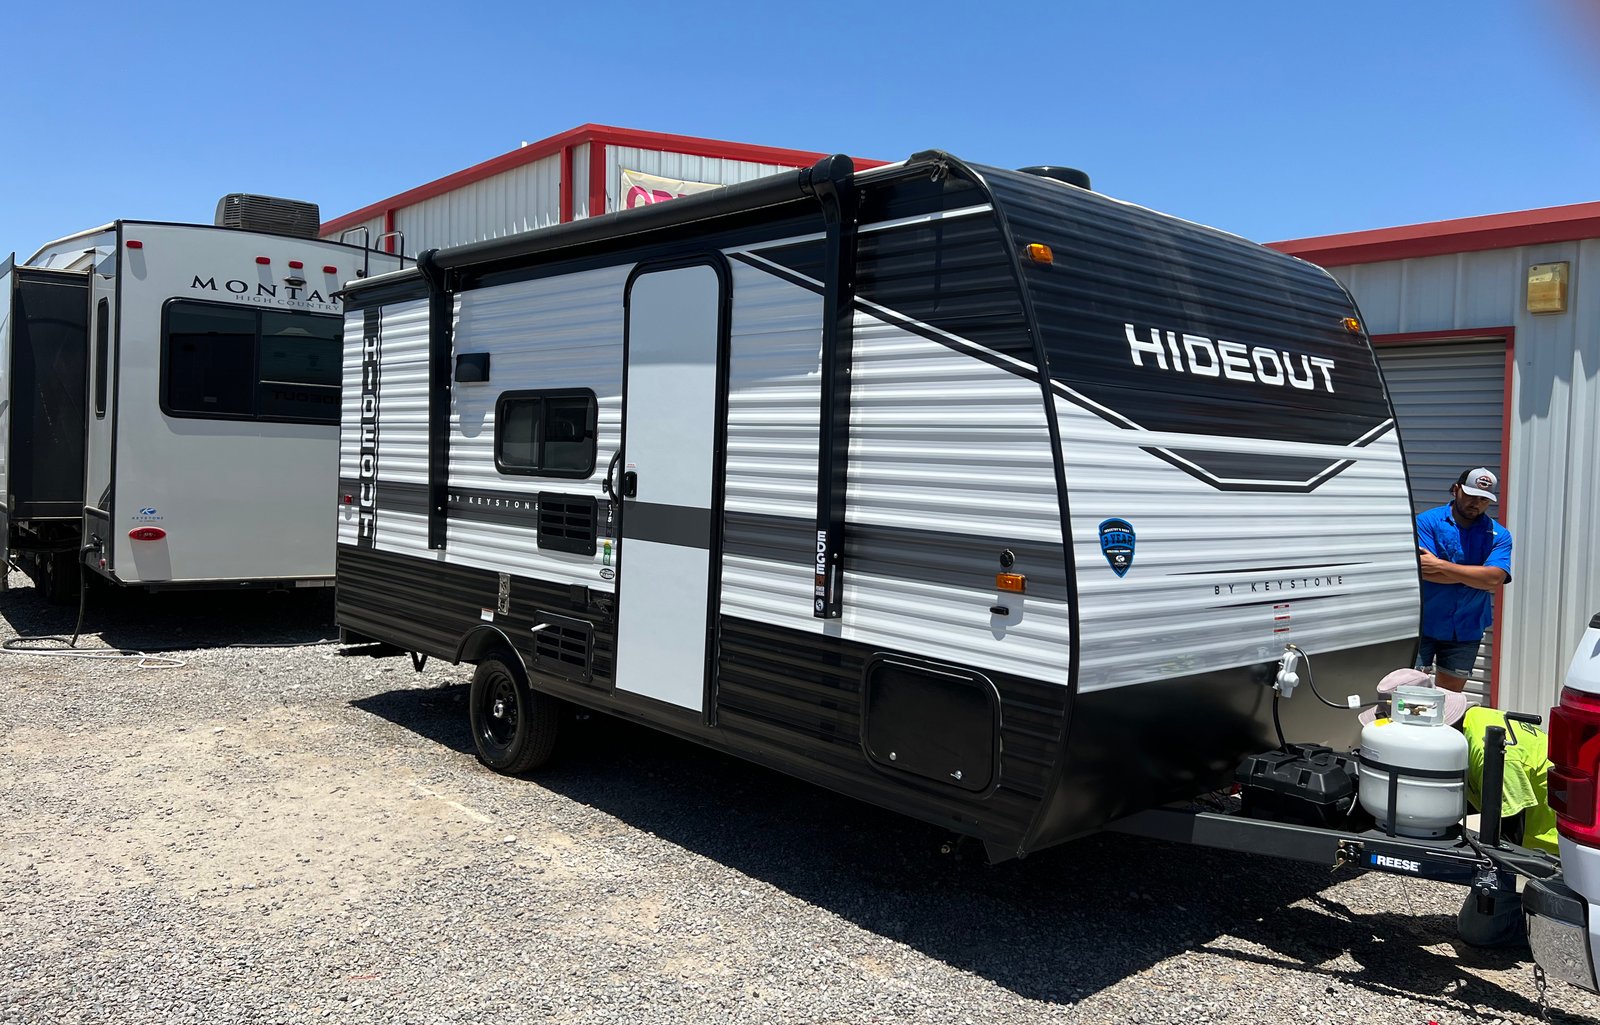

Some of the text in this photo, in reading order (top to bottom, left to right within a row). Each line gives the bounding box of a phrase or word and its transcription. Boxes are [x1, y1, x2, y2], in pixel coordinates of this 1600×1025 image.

[235, 294, 340, 311] HIGH COUNTRY
[1124, 323, 1335, 393] HIDEOUT
[360, 337, 377, 537] HIDEOUT
[448, 494, 539, 511] BY KEYSTONE
[1110, 533, 1133, 547] YEAR
[816, 530, 827, 575] EDGE
[1214, 575, 1343, 595] BY KEYSTONE
[1377, 855, 1419, 872] REESE
